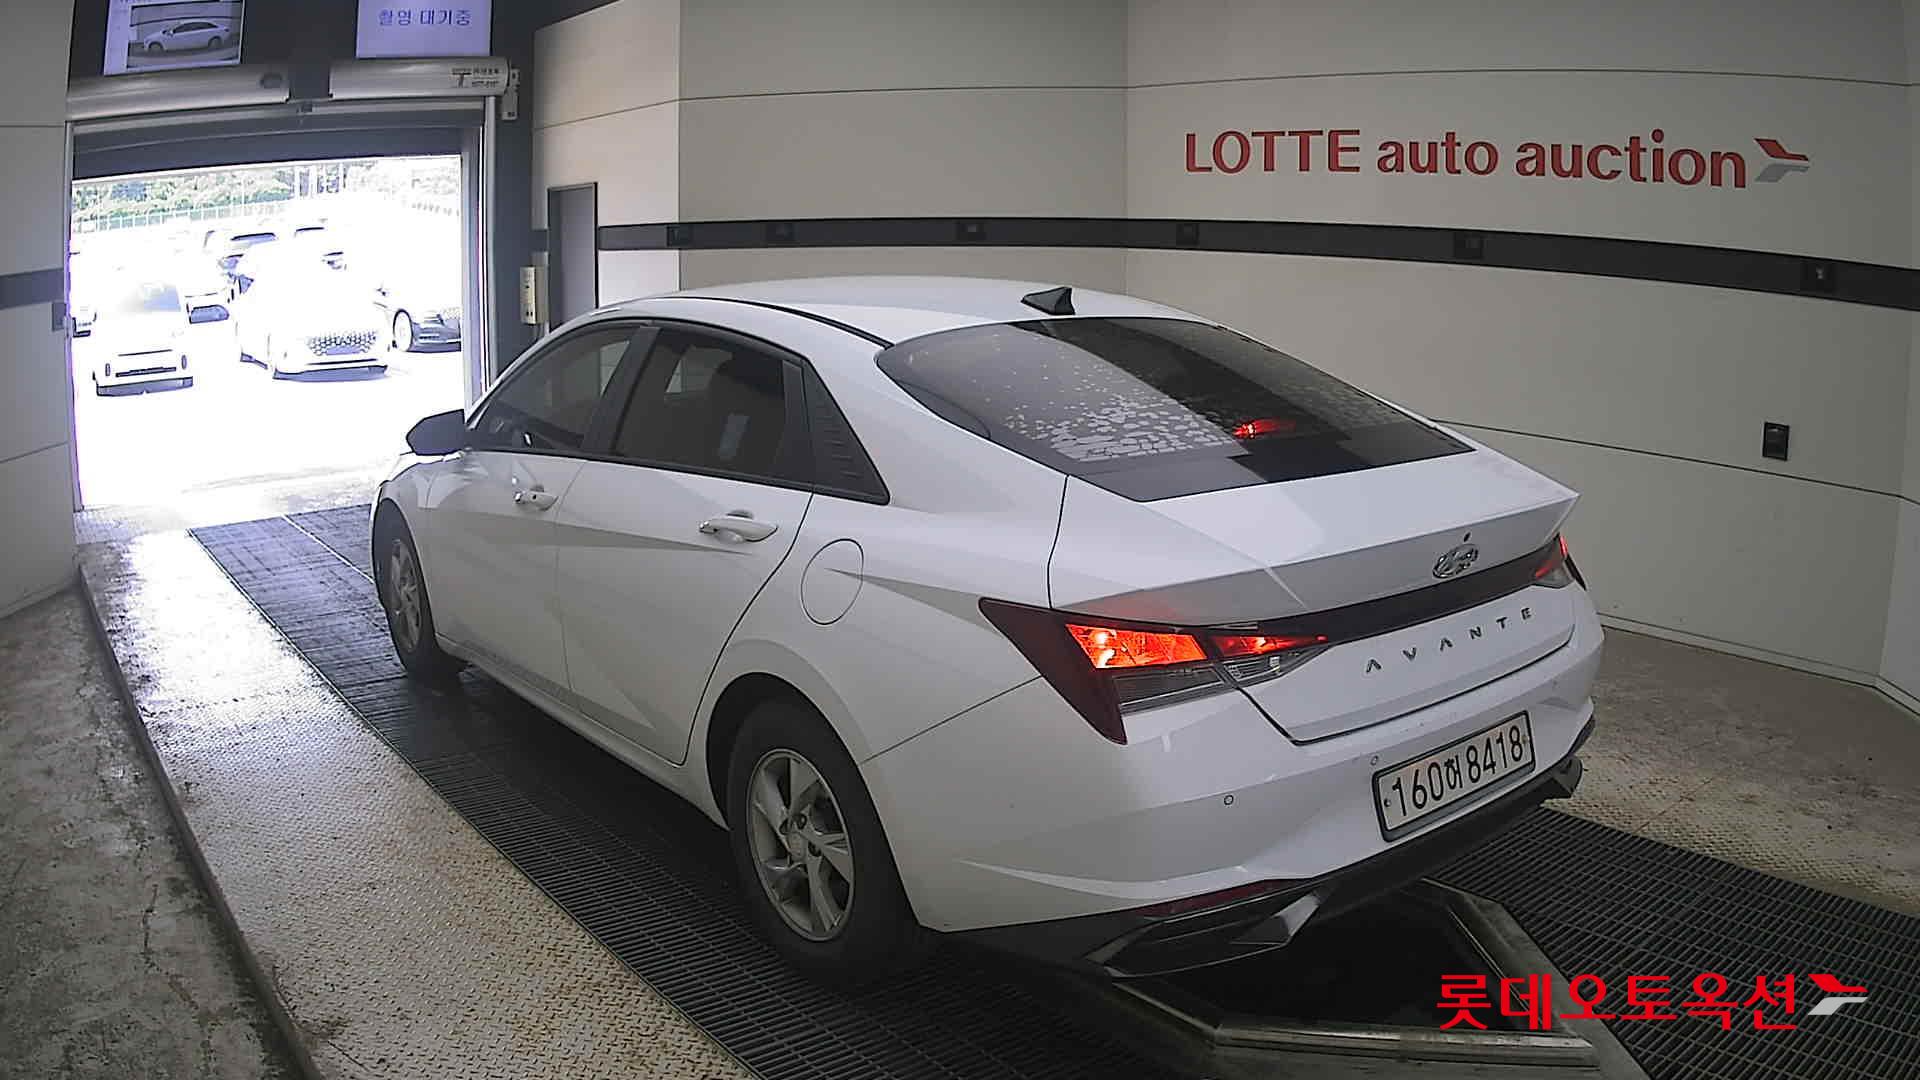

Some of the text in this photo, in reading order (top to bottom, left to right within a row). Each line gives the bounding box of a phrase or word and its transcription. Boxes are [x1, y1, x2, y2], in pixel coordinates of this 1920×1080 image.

[420, 9, 473, 26] 대기중
[1186, 130, 1746, 187] LOTTE auto auction
[1365, 606, 1533, 674] AVANTE
